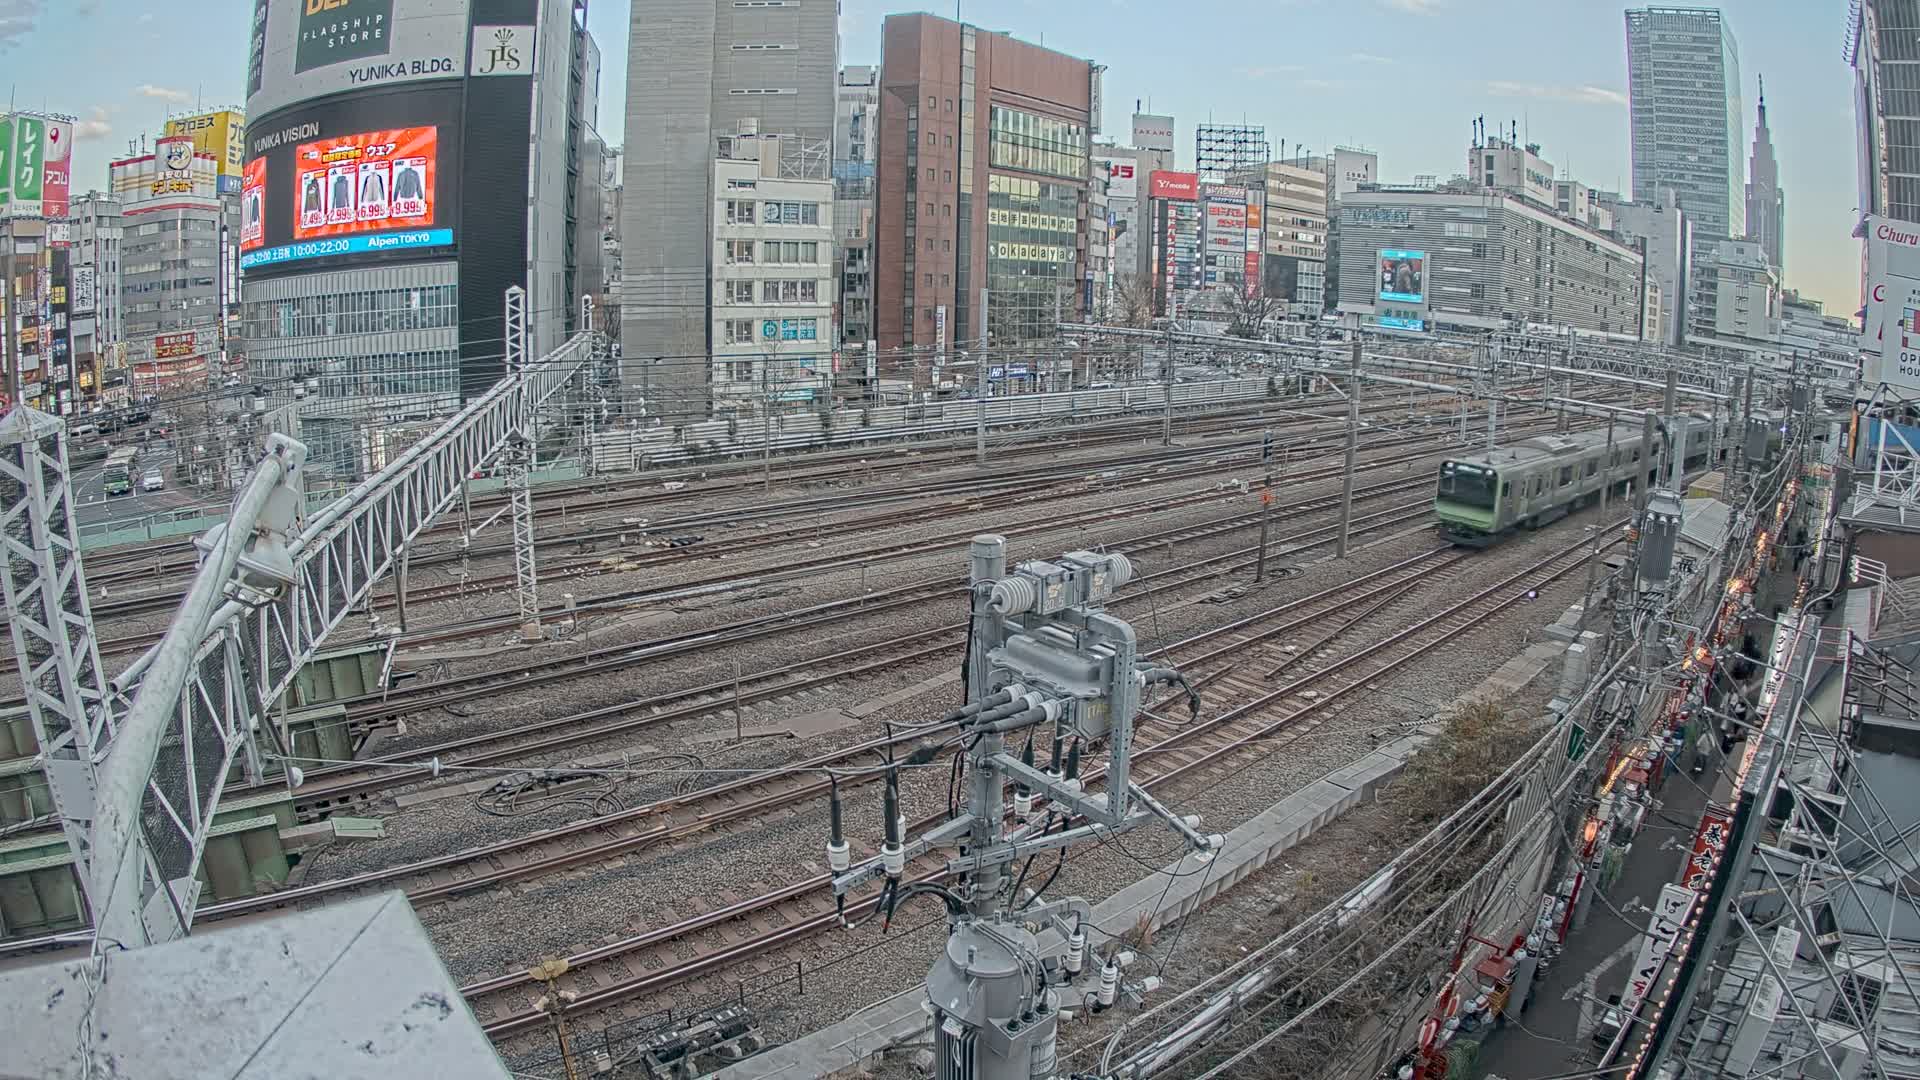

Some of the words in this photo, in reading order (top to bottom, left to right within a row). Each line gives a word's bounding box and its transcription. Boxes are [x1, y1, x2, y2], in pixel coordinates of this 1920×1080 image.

[303, 14, 383, 41] FLAGSHIP
[327, 28, 382, 48] STORE
[350, 62, 408, 84] YUNIKA
[411, 57, 456, 76] BLDG.
[175, 117, 215, 133] プロミス
[254, 132, 281, 154] YUNIKA
[282, 121, 320, 145] VISION
[20, 121, 37, 188] レイク
[45, 170, 68, 185] アコム
[293, 239, 349, 257] 10:00-22:00
[368, 236, 398, 249] Alpen
[399, 233, 430, 245] TOKYO
[1000, 246, 1067, 261] okadaya
